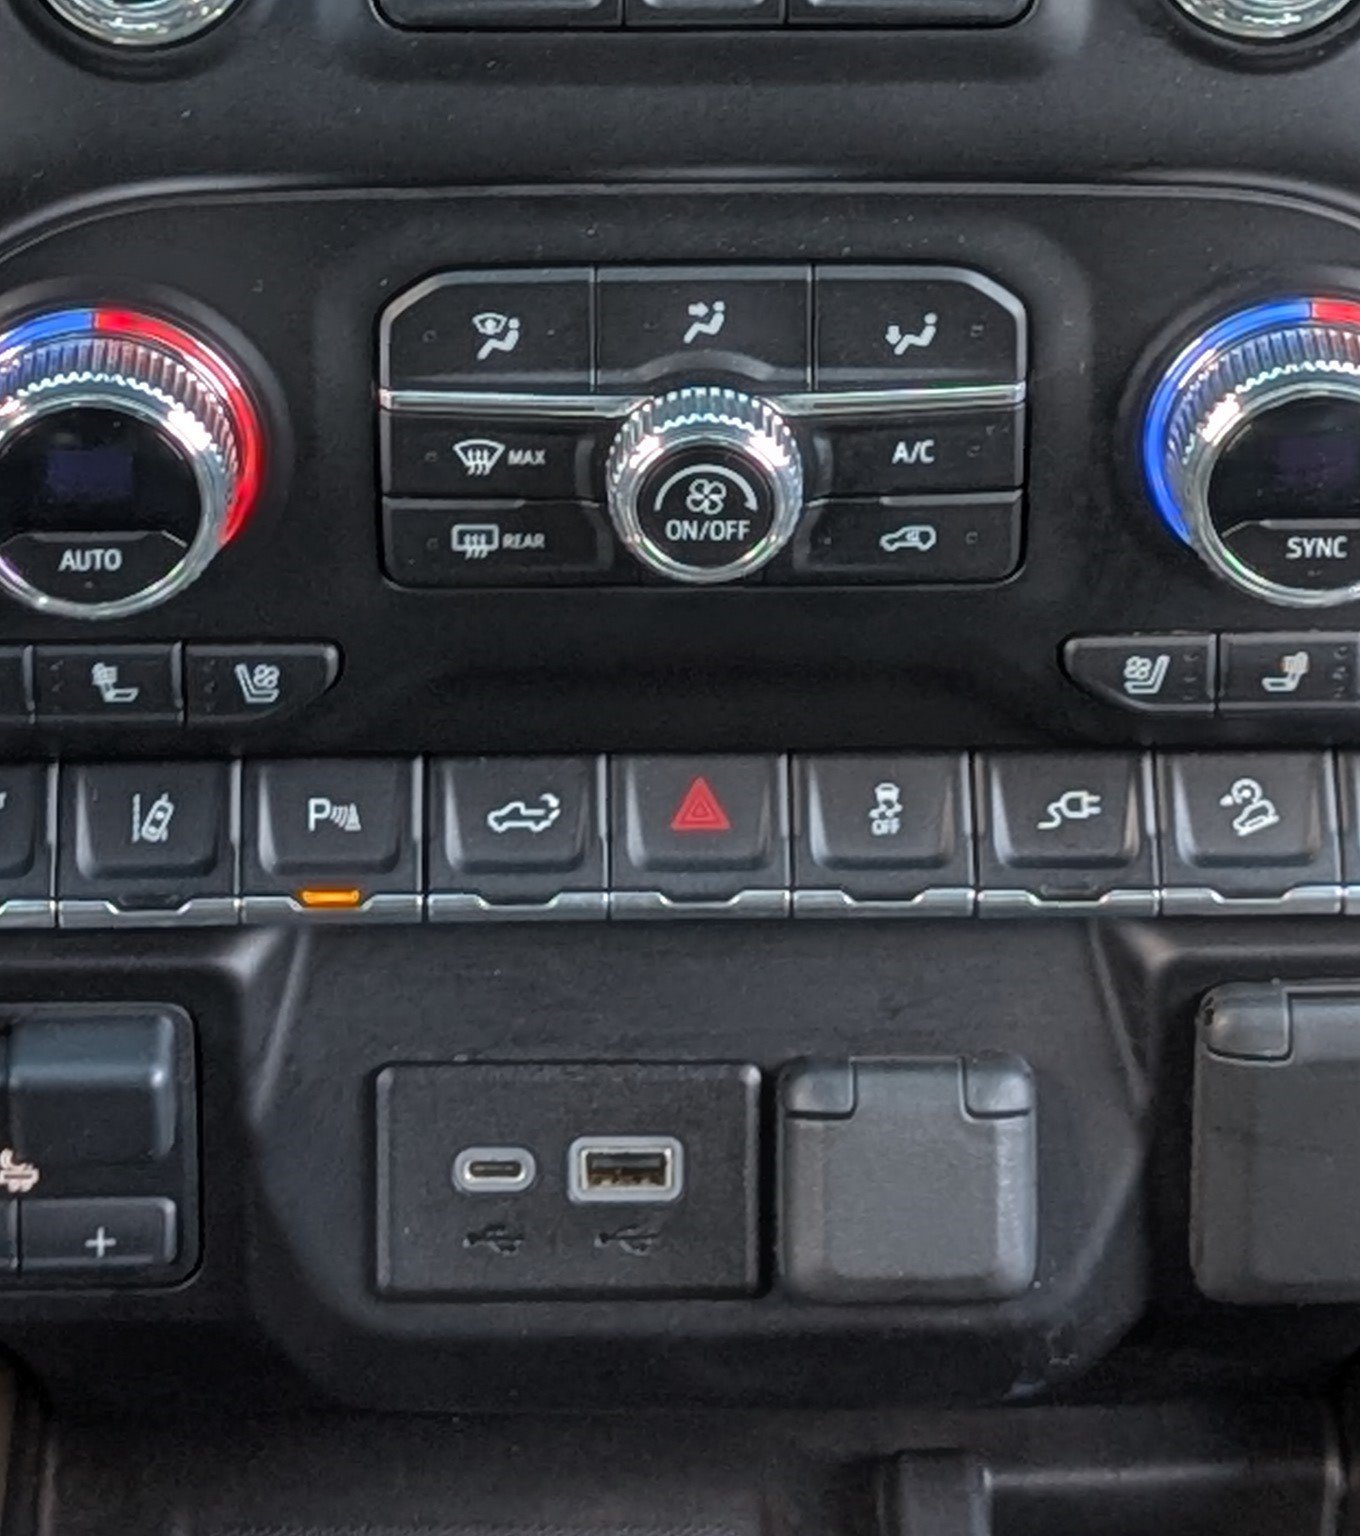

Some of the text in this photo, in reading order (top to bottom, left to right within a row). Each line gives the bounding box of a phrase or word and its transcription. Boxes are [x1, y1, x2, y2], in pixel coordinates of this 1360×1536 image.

[508, 448, 546, 467] MAX
[892, 439, 935, 464] A/C
[503, 532, 546, 550] REAR
[665, 519, 750, 541] ON/OFF
[1286, 536, 1348, 560] SYNC
[59, 548, 122, 571] AUTO
[871, 817, 900, 835] OFF
